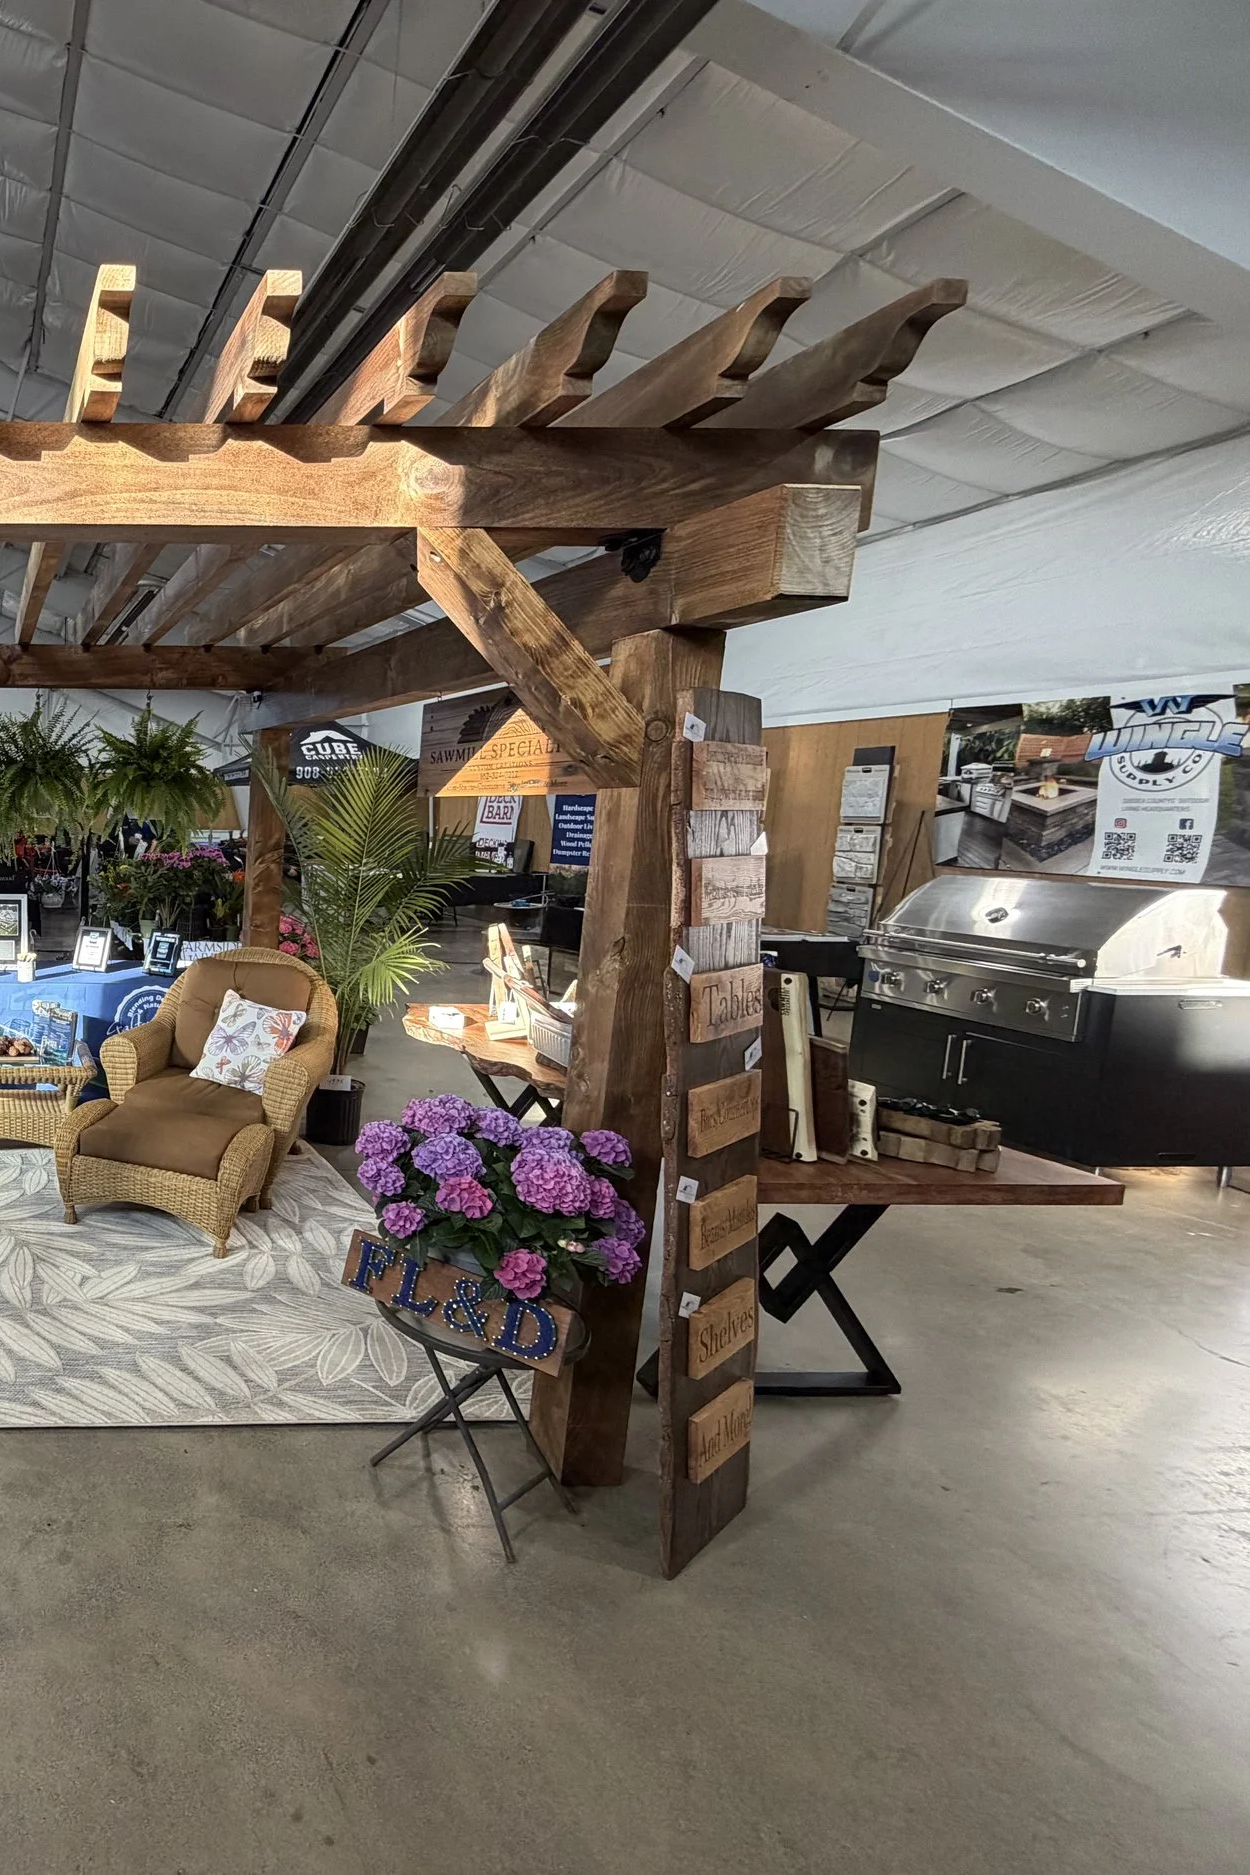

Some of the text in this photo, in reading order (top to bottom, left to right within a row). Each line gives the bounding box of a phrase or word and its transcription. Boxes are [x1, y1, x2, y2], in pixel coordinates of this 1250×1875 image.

[301, 742, 361, 755] CUBE
[430, 747, 487, 764] SAWMILL
[1085, 721, 1250, 762] WINGLE
[1117, 755, 1176, 787] SUPPLY
[127, 995, 154, 1017] Blending
[702, 978, 762, 1027] Tables
[699, 1306, 754, 1364] Shelves
[699, 1418, 721, 1468] And
